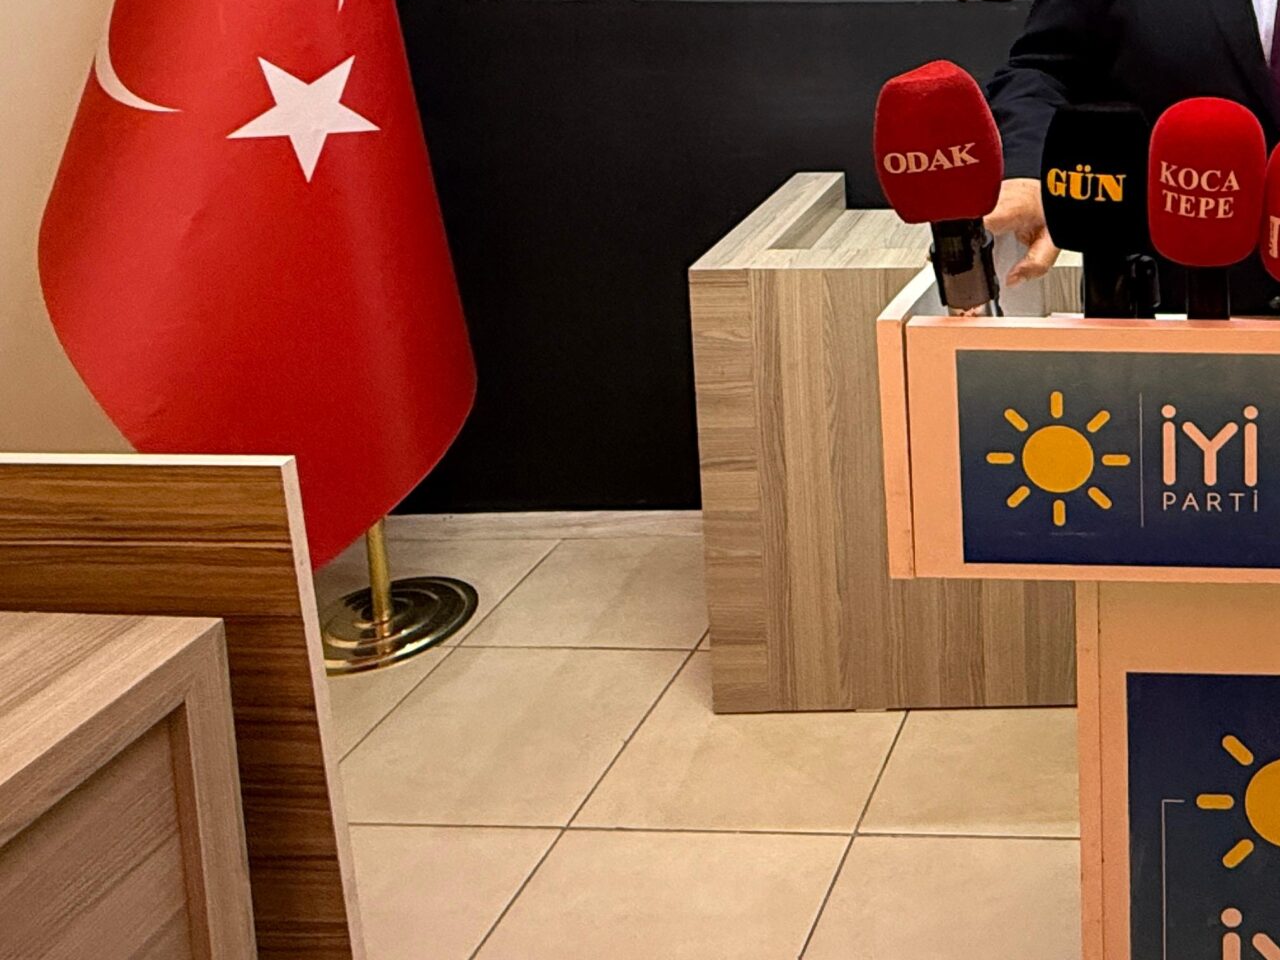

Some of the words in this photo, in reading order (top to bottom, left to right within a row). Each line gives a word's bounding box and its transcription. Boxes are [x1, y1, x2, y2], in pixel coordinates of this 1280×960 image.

[883, 142, 980, 174] ODAK
[1047, 164, 1127, 202] GÜN
[1159, 161, 1240, 192] KOCA
[1162, 190, 1235, 219] TEPE
[1161, 404, 1259, 487] İYİ
[1162, 489, 1258, 513] PARTİ
